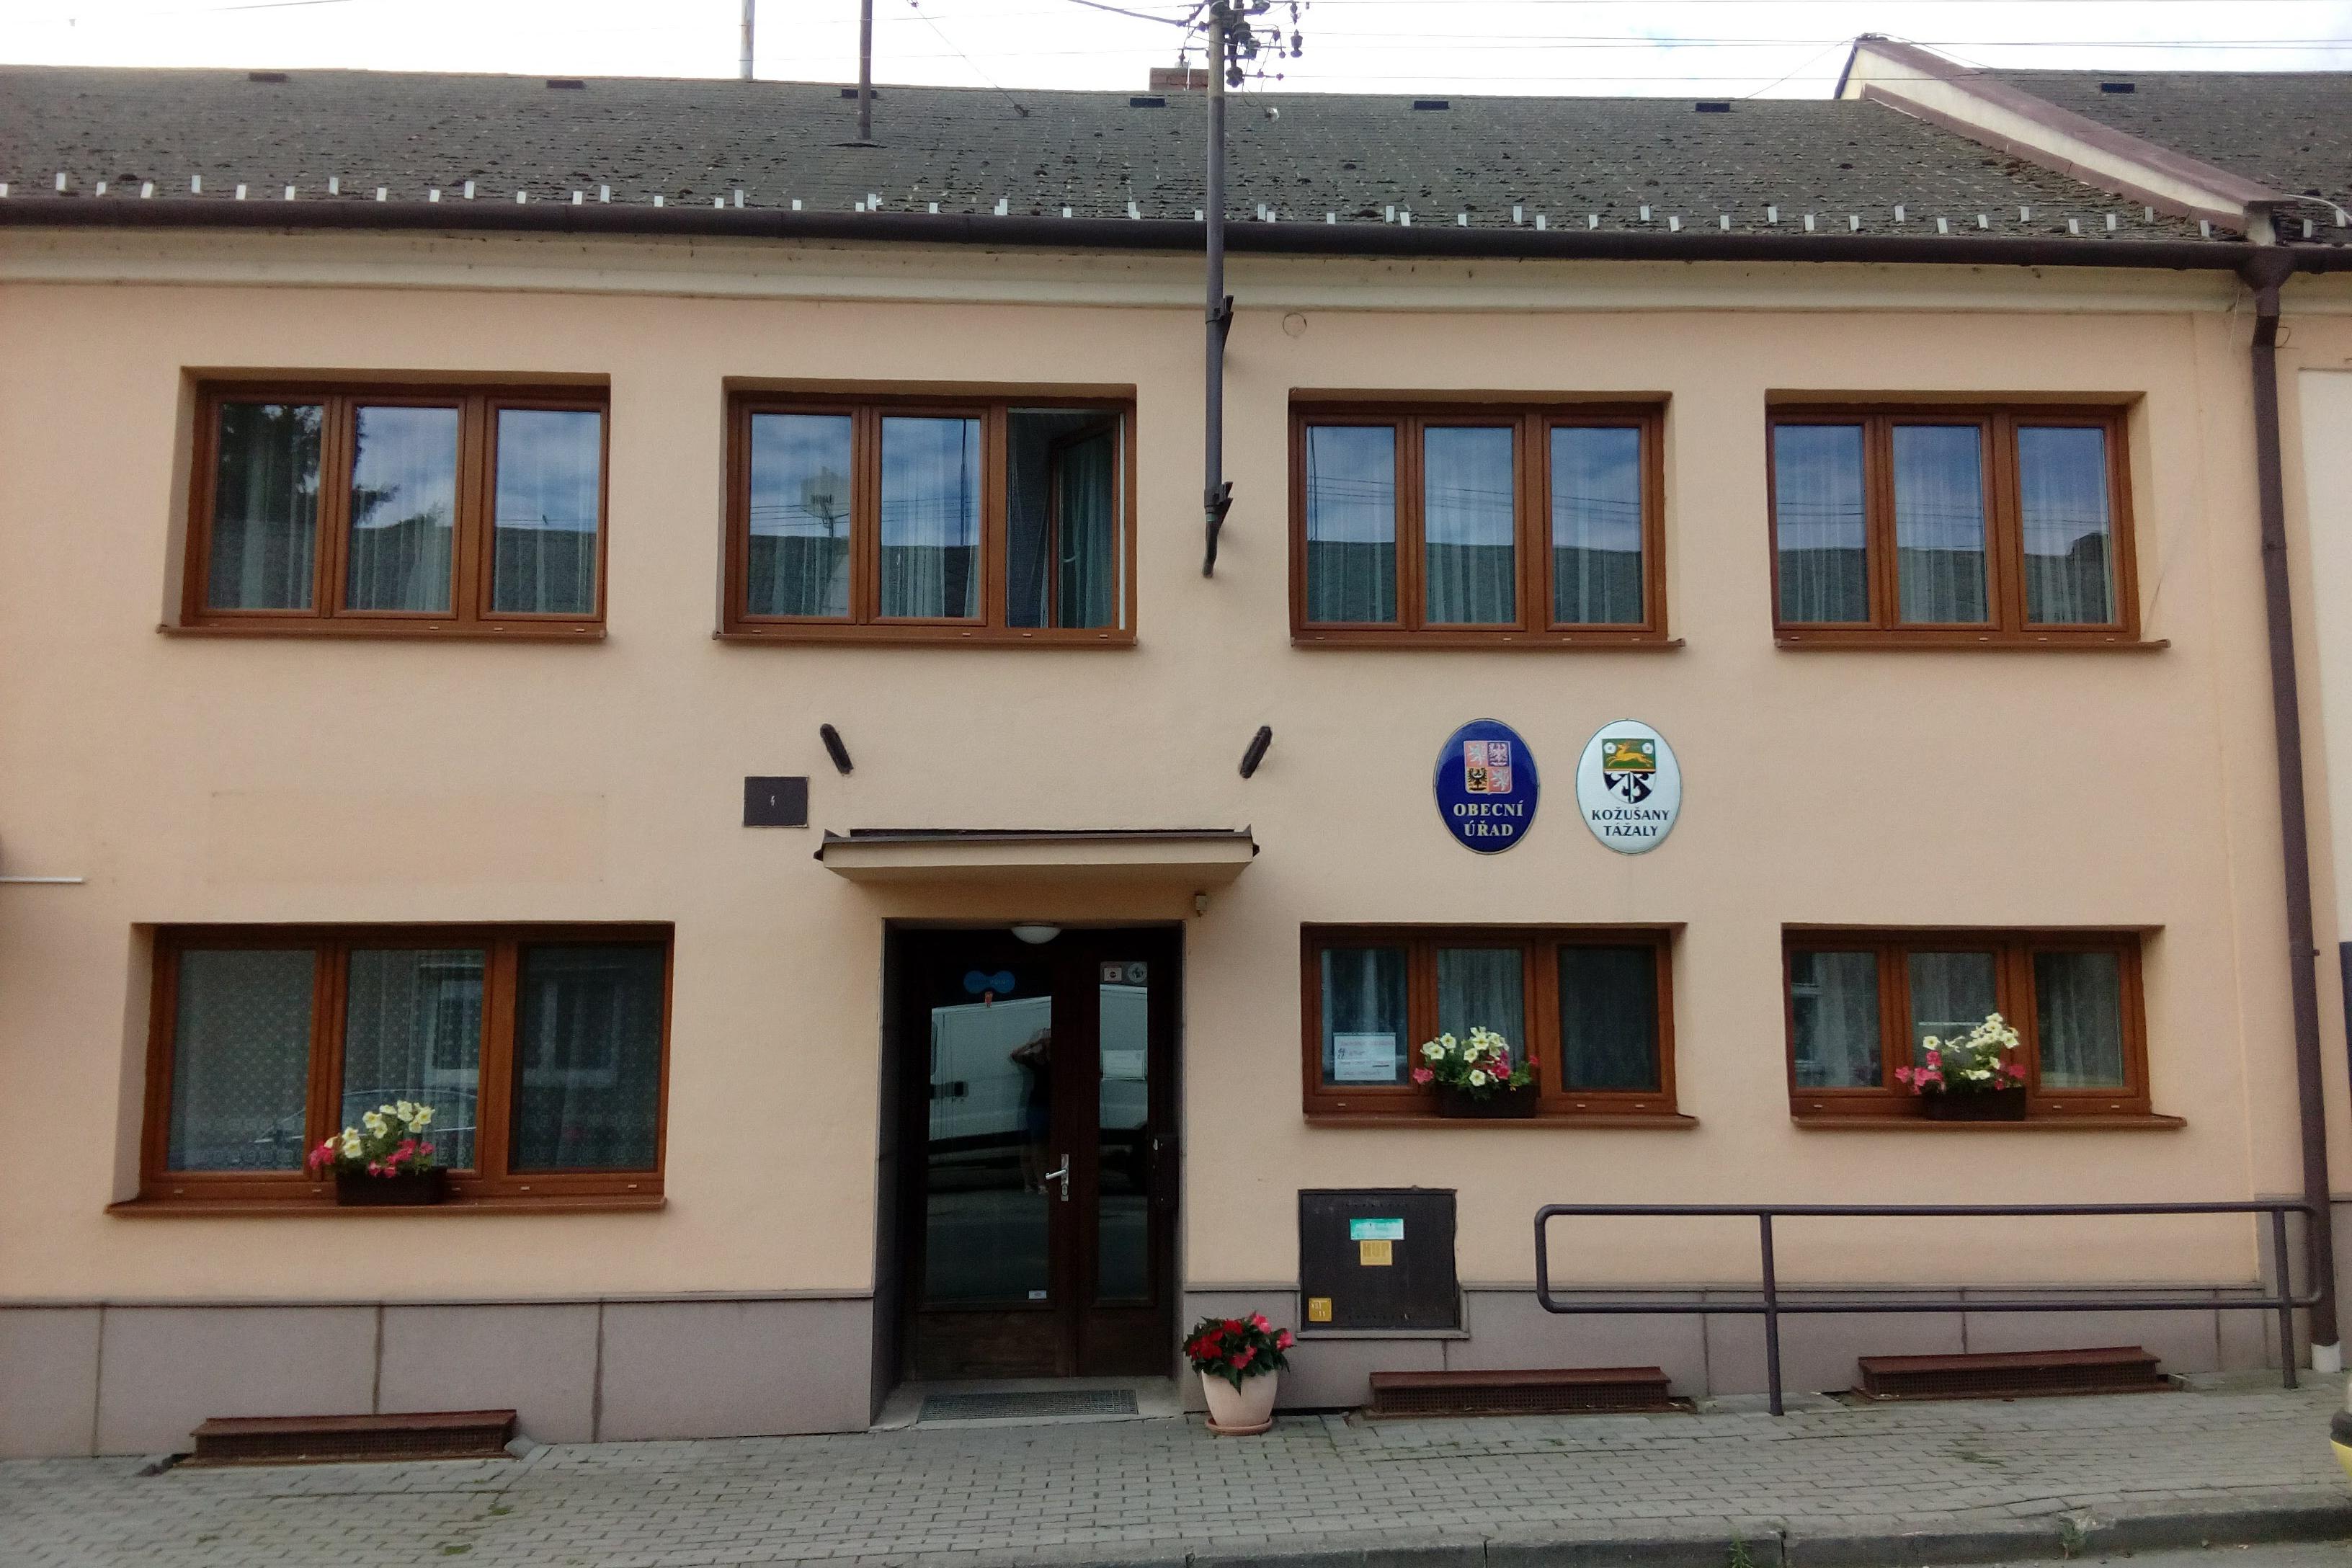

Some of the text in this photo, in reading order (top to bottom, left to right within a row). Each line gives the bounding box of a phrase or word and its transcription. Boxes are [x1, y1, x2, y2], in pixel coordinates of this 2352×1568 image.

[1453, 800, 1523, 816] OBECNÍ
[1592, 807, 1669, 820] KOŽUŠANY
[1464, 820, 1513, 836] ÚŘAD
[1603, 823, 1657, 836] TÁŽALY
